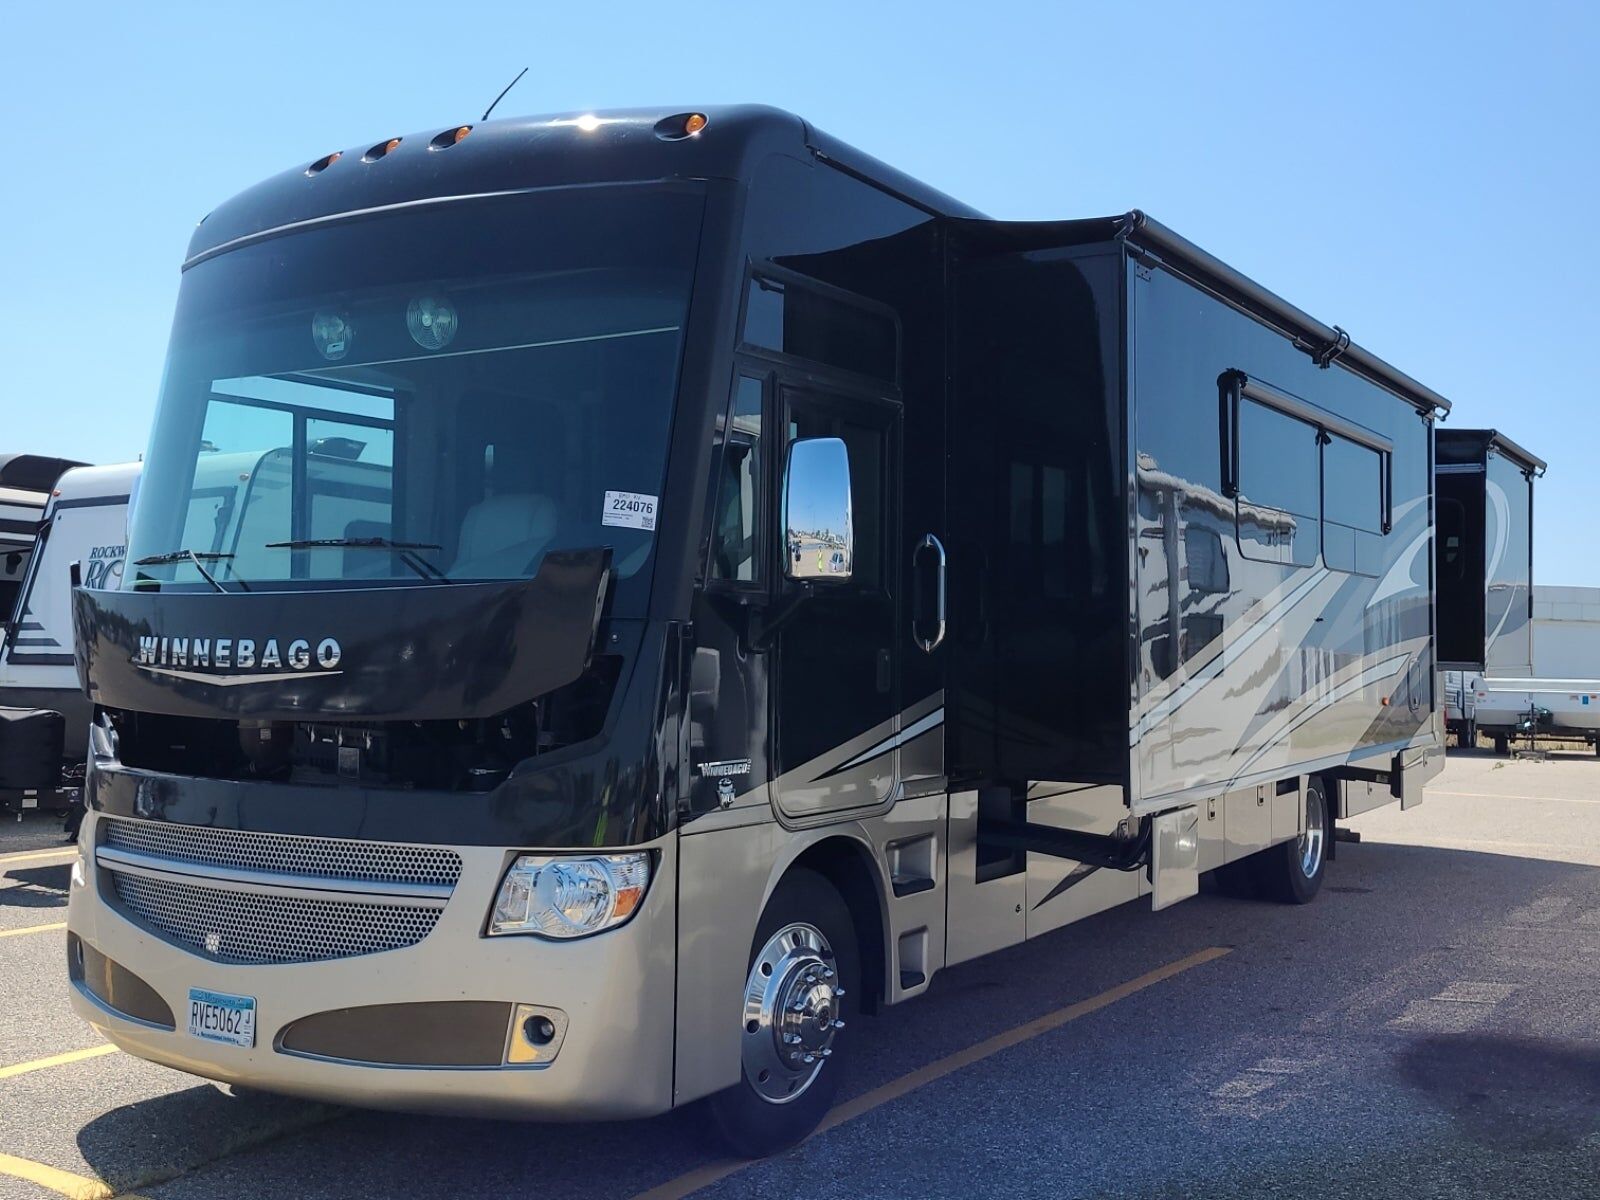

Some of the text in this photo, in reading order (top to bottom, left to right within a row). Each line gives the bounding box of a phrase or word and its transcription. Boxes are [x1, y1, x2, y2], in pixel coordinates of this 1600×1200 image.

[613, 498, 653, 514] 224076
[139, 636, 342, 670] WINNEBAGO
[191, 1001, 242, 1034] RVE5062
